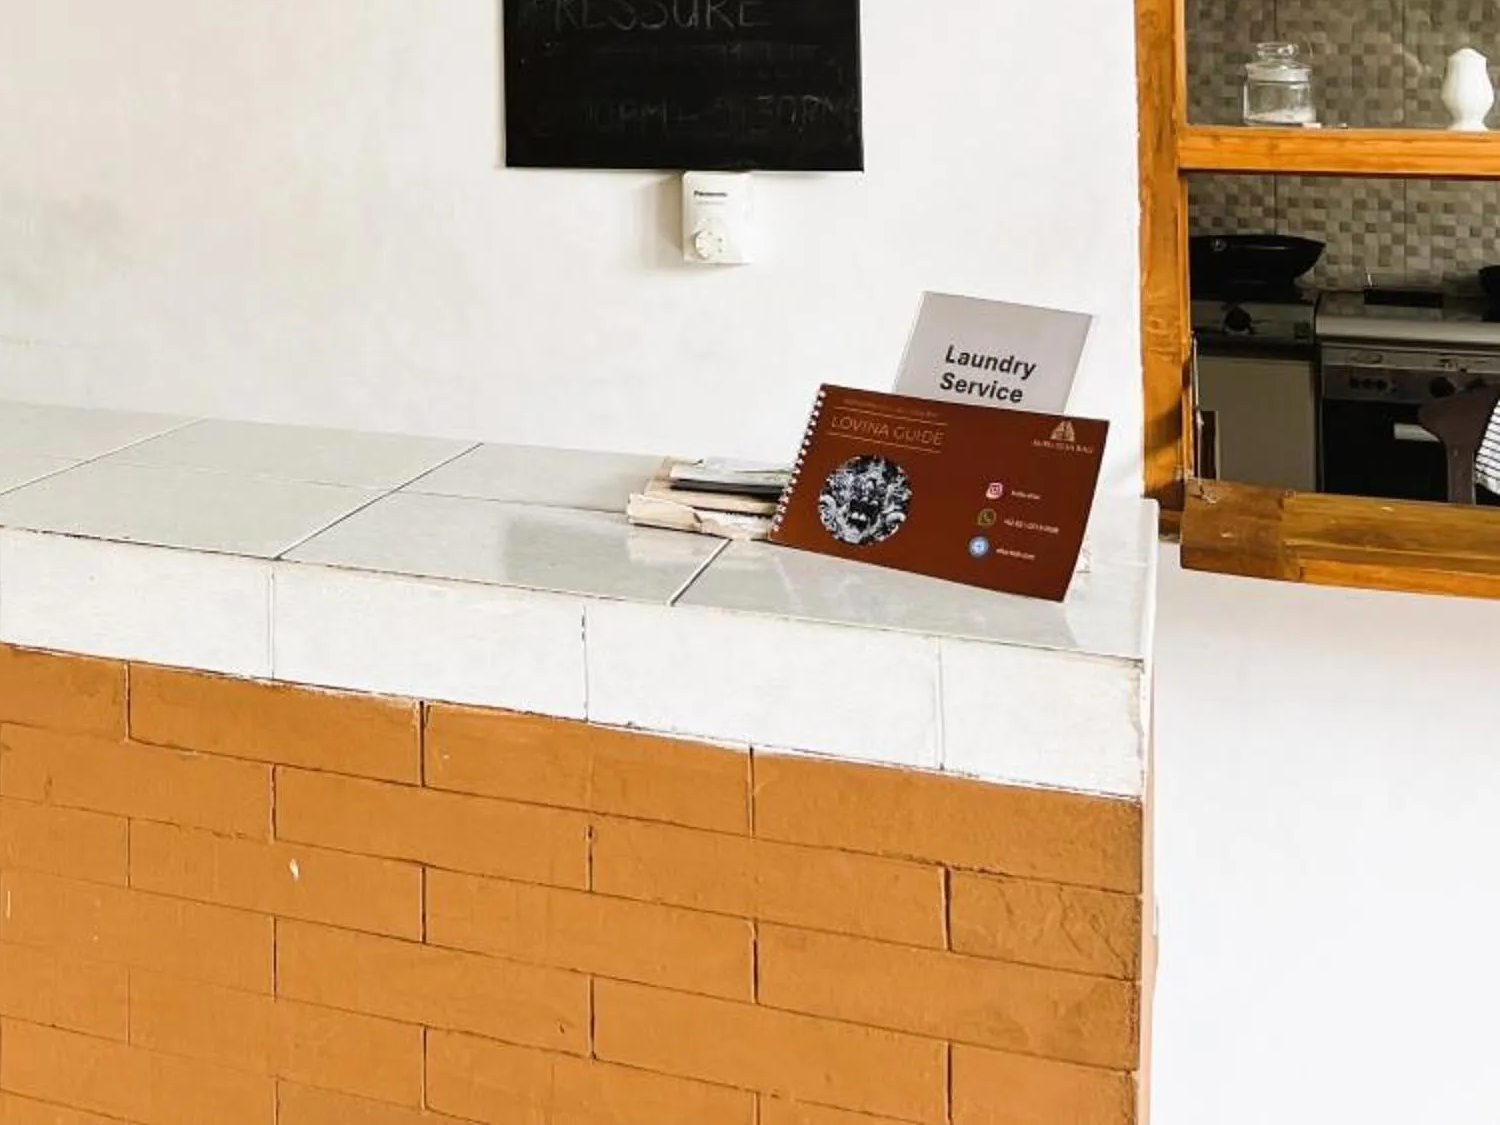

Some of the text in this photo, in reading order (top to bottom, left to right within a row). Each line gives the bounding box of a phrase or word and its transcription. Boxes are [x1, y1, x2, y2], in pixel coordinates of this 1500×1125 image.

[946, 344, 1037, 380] Laundry
[940, 372, 1023, 403] Service
[831, 415, 945, 446] LOVINA GUIDE
